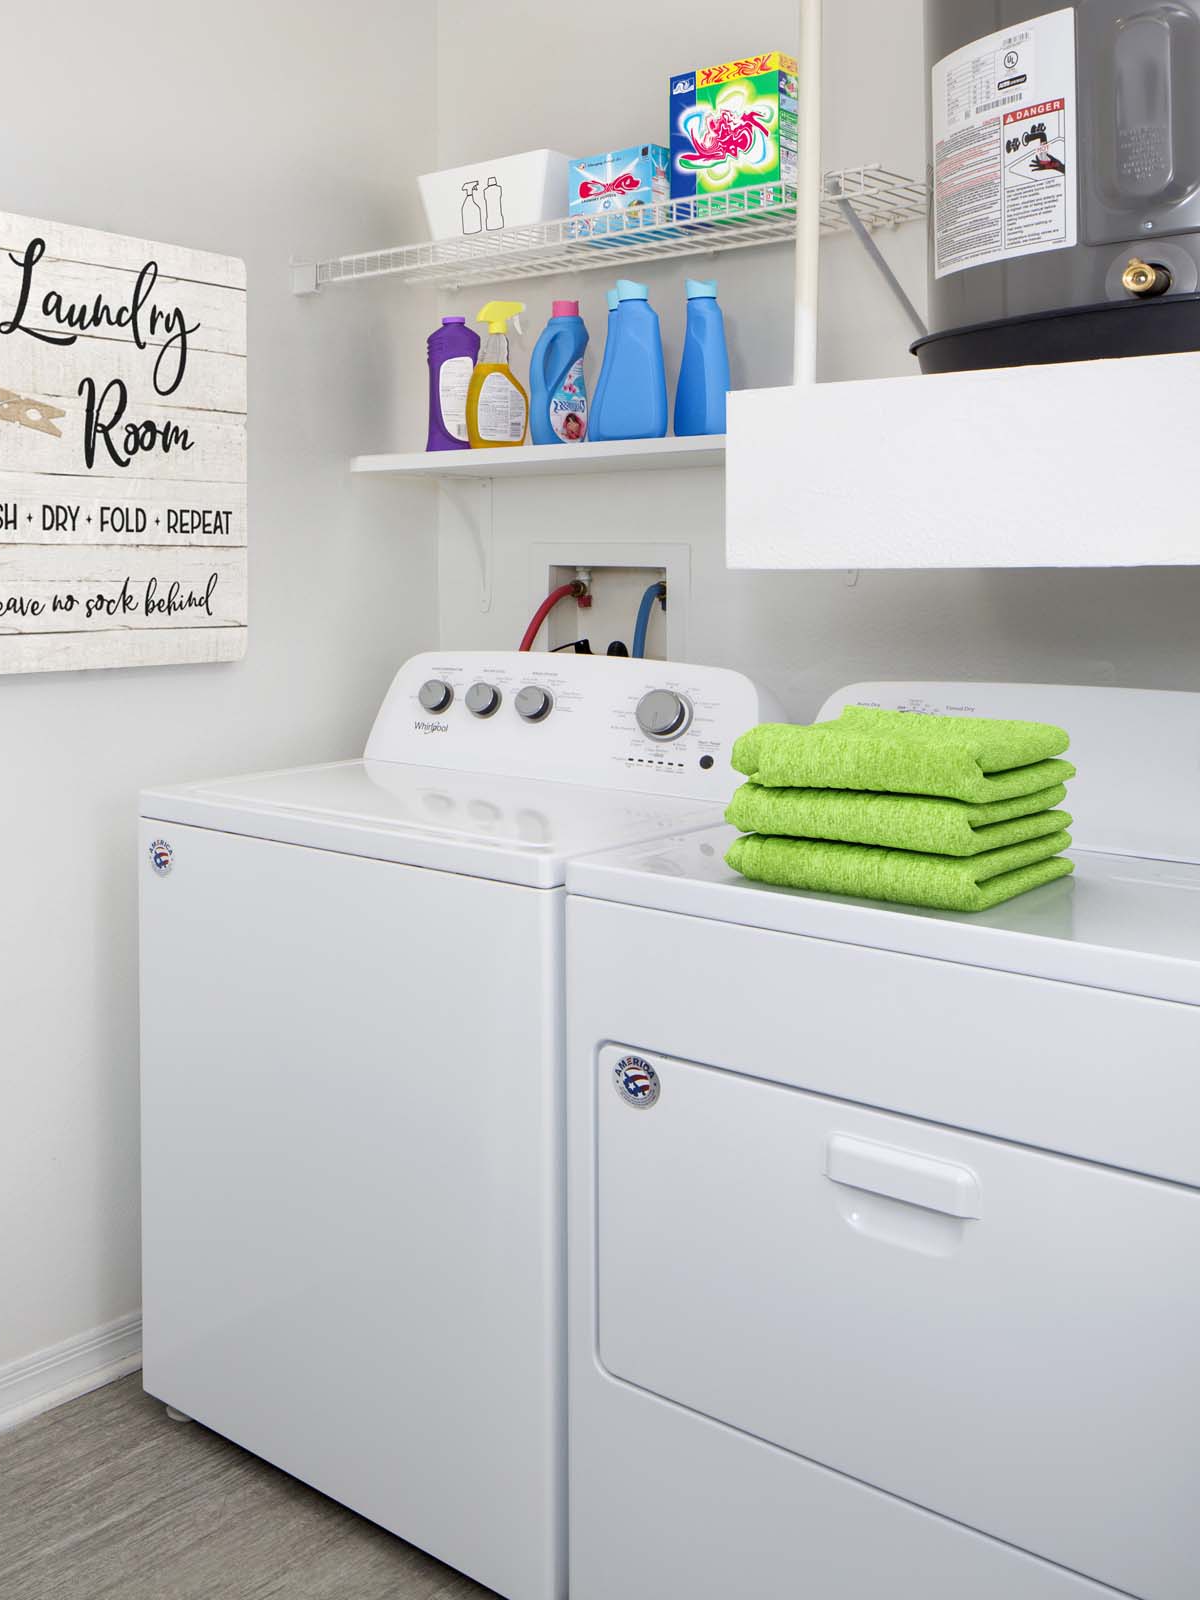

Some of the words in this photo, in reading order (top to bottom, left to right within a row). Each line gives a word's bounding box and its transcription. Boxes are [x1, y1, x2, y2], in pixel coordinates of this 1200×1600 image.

[1016, 101, 1060, 119] DANGER
[78, 377, 194, 469] Room
[42, 505, 80, 532] DRY
[100, 507, 147, 533] FOLD
[167, 509, 233, 535] REPEAT
[52, 594, 80, 613] no
[85, 576, 138, 618] sock
[145, 573, 218, 617] behind
[415, 721, 448, 735] Whirlpool
